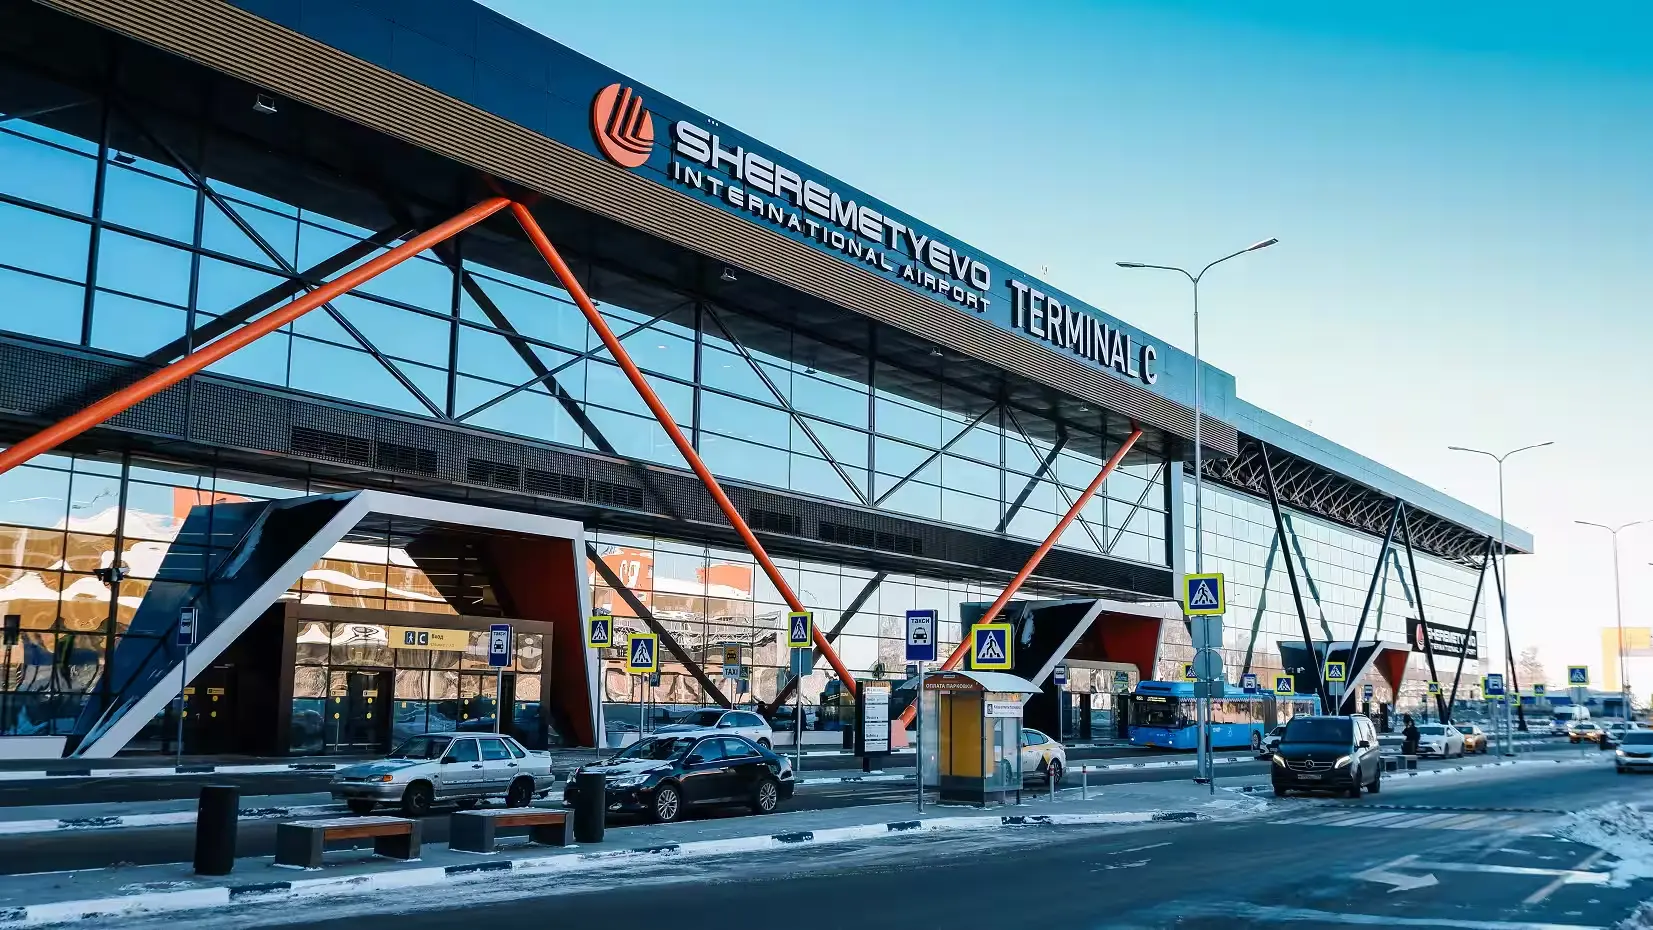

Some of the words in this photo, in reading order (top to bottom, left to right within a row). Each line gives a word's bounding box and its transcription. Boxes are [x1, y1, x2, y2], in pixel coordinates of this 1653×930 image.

[674, 161, 893, 271] INTERNATIONAL
[902, 265, 990, 312] AIRPORT
[675, 120, 990, 291] SHEREMETYEVO
[1011, 279, 1139, 378] TERMINAL
[1143, 344, 1158, 385] C
[725, 668, 737, 676] TAXI
